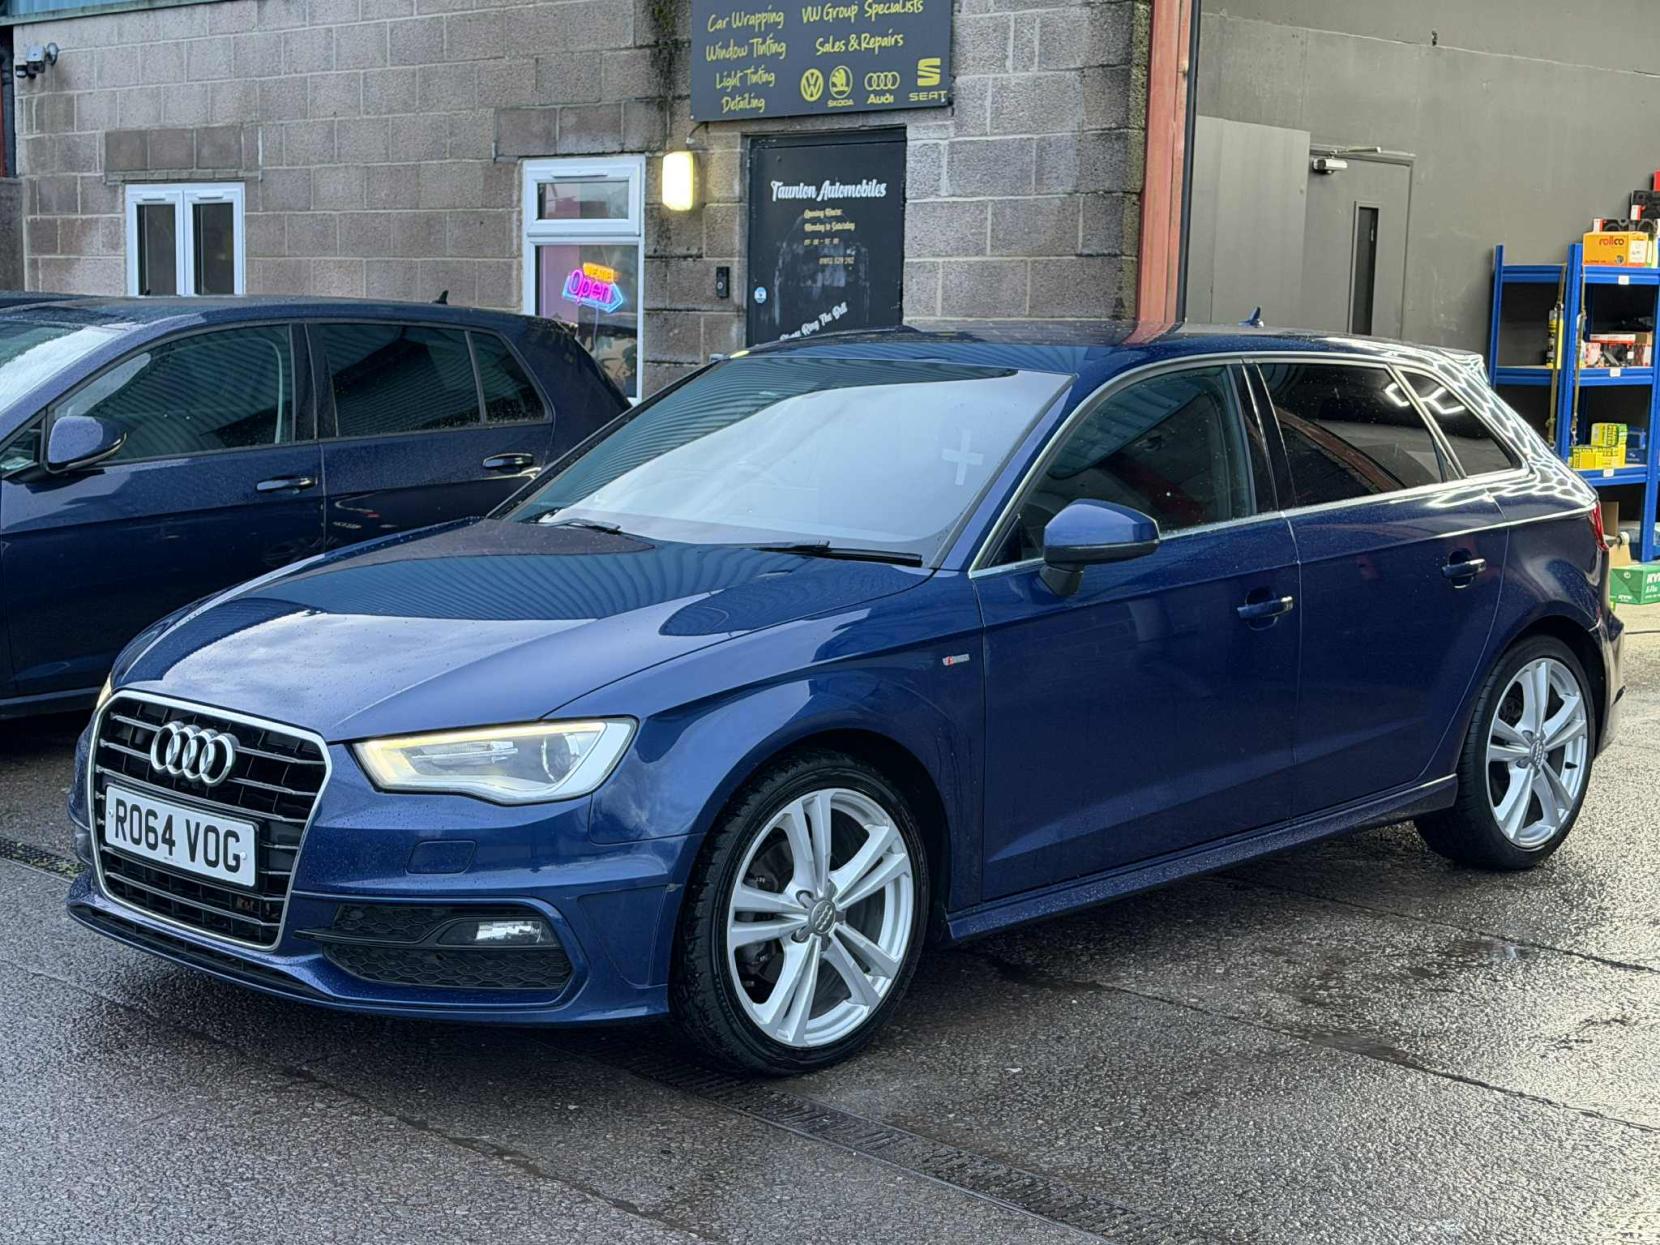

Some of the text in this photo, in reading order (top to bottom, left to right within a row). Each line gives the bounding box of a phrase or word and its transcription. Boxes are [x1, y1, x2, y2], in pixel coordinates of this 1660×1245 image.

[707, 4, 784, 32] Car Wrapping
[823, 3, 858, 24] Group
[864, 0, 924, 22] Specialists
[705, 32, 787, 61] Window Tinting
[815, 28, 904, 55] Sales & Repairs
[715, 64, 776, 92] Light Tinting
[721, 92, 766, 114] Detailing
[867, 93, 894, 104] Audi
[908, 90, 948, 103] SEAT
[770, 179, 887, 202] Taunton Automobiles
[1599, 237, 1625, 246] rollco
[568, 269, 612, 305] Open
[115, 798, 241, 874] RO64 VOG
